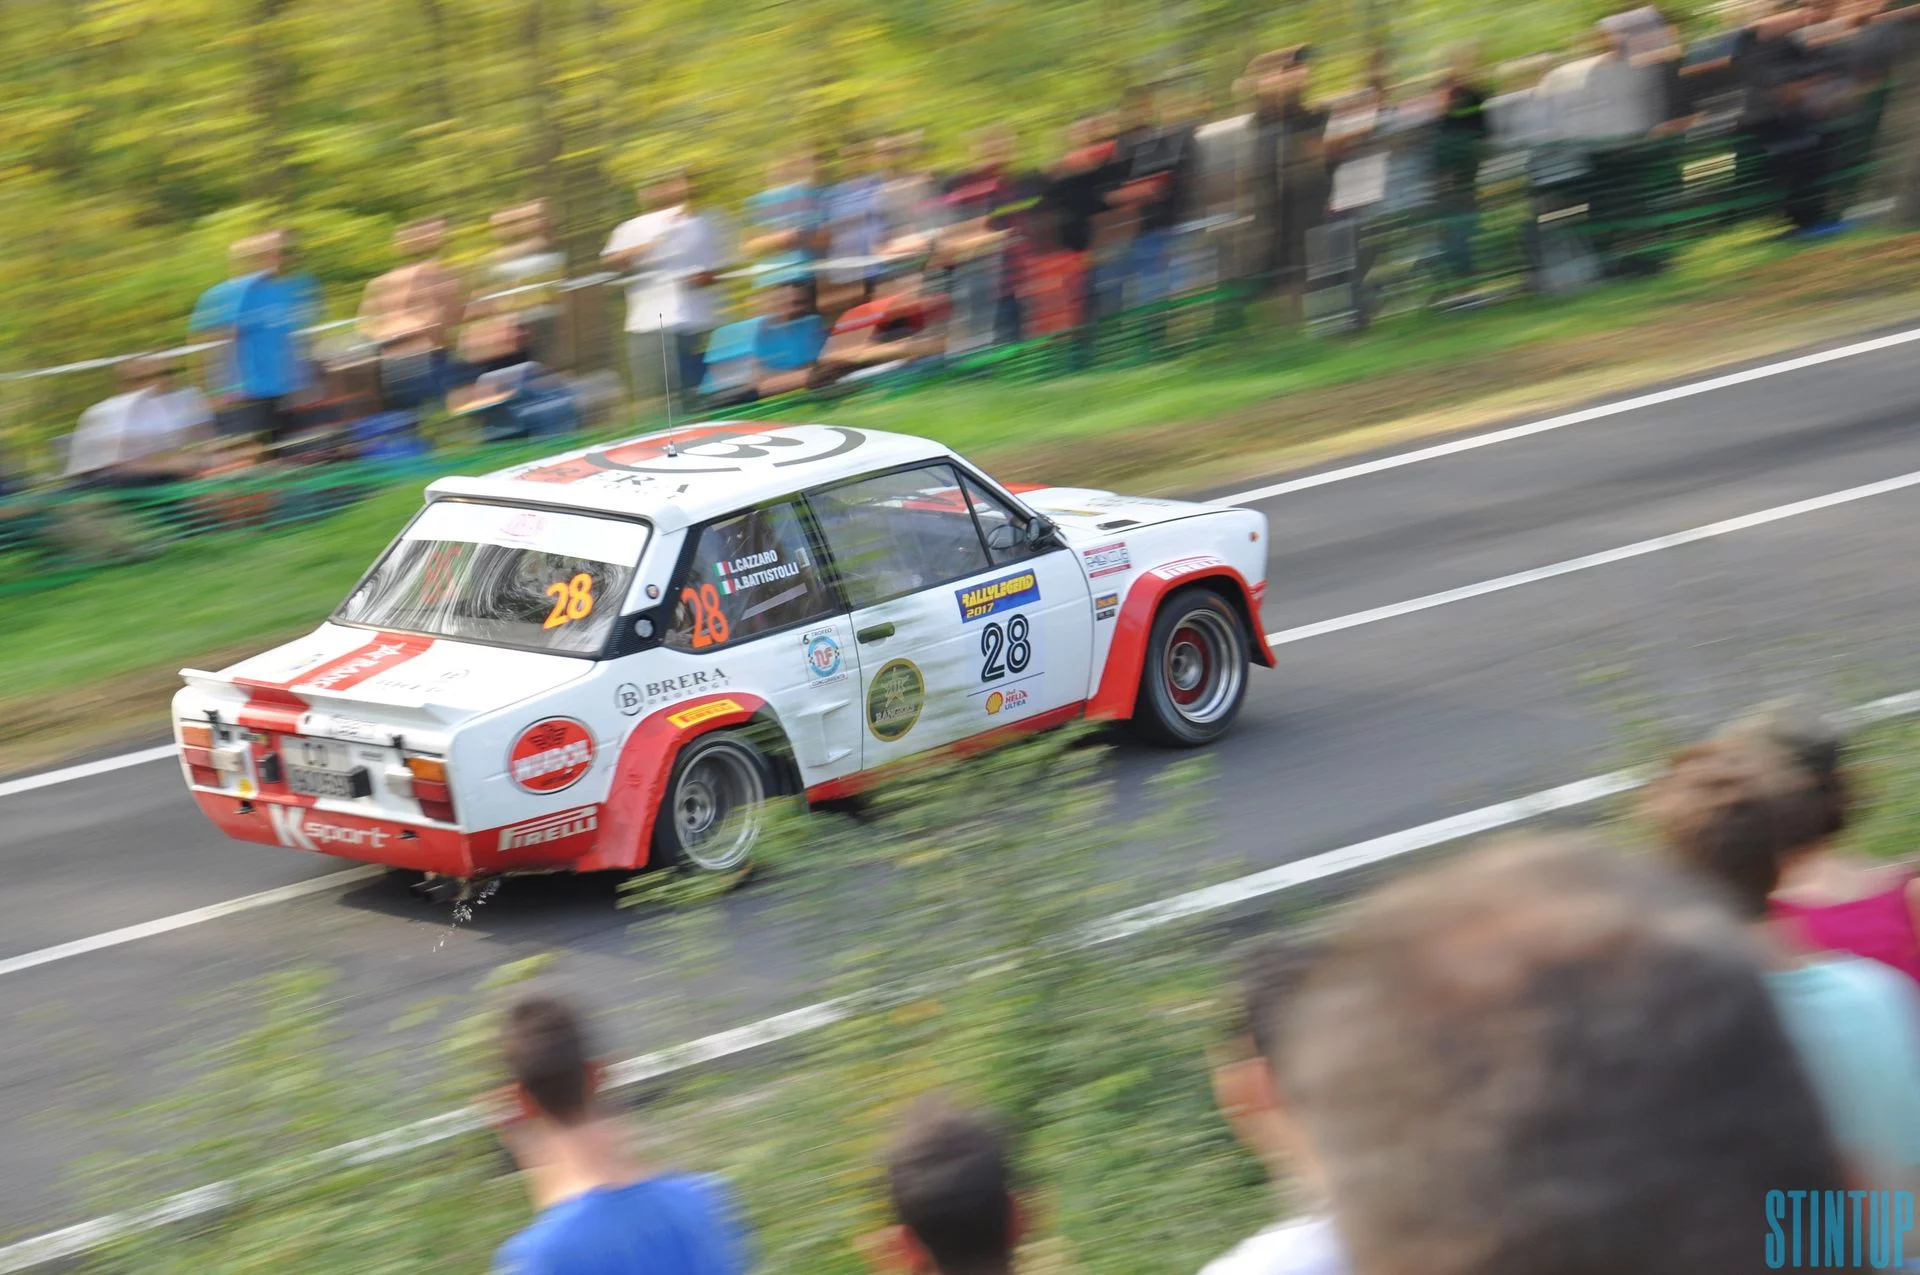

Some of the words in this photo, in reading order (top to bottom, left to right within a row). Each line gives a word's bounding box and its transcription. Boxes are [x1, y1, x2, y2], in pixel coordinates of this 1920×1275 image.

[728, 549, 778, 573] L.CAZZARO
[735, 562, 800, 590] A.BATTISTOLLI
[543, 572, 594, 630] 28
[962, 573, 1035, 607] RALLYLEGEND
[681, 583, 729, 648] 28
[966, 602, 994, 619] 2017
[981, 613, 1031, 683] 28
[645, 667, 726, 697] BRERA
[1004, 699, 1026, 711] ULTRA
[267, 803, 321, 851] K
[303, 821, 391, 848] sport
[497, 804, 598, 852] PIRELLI
